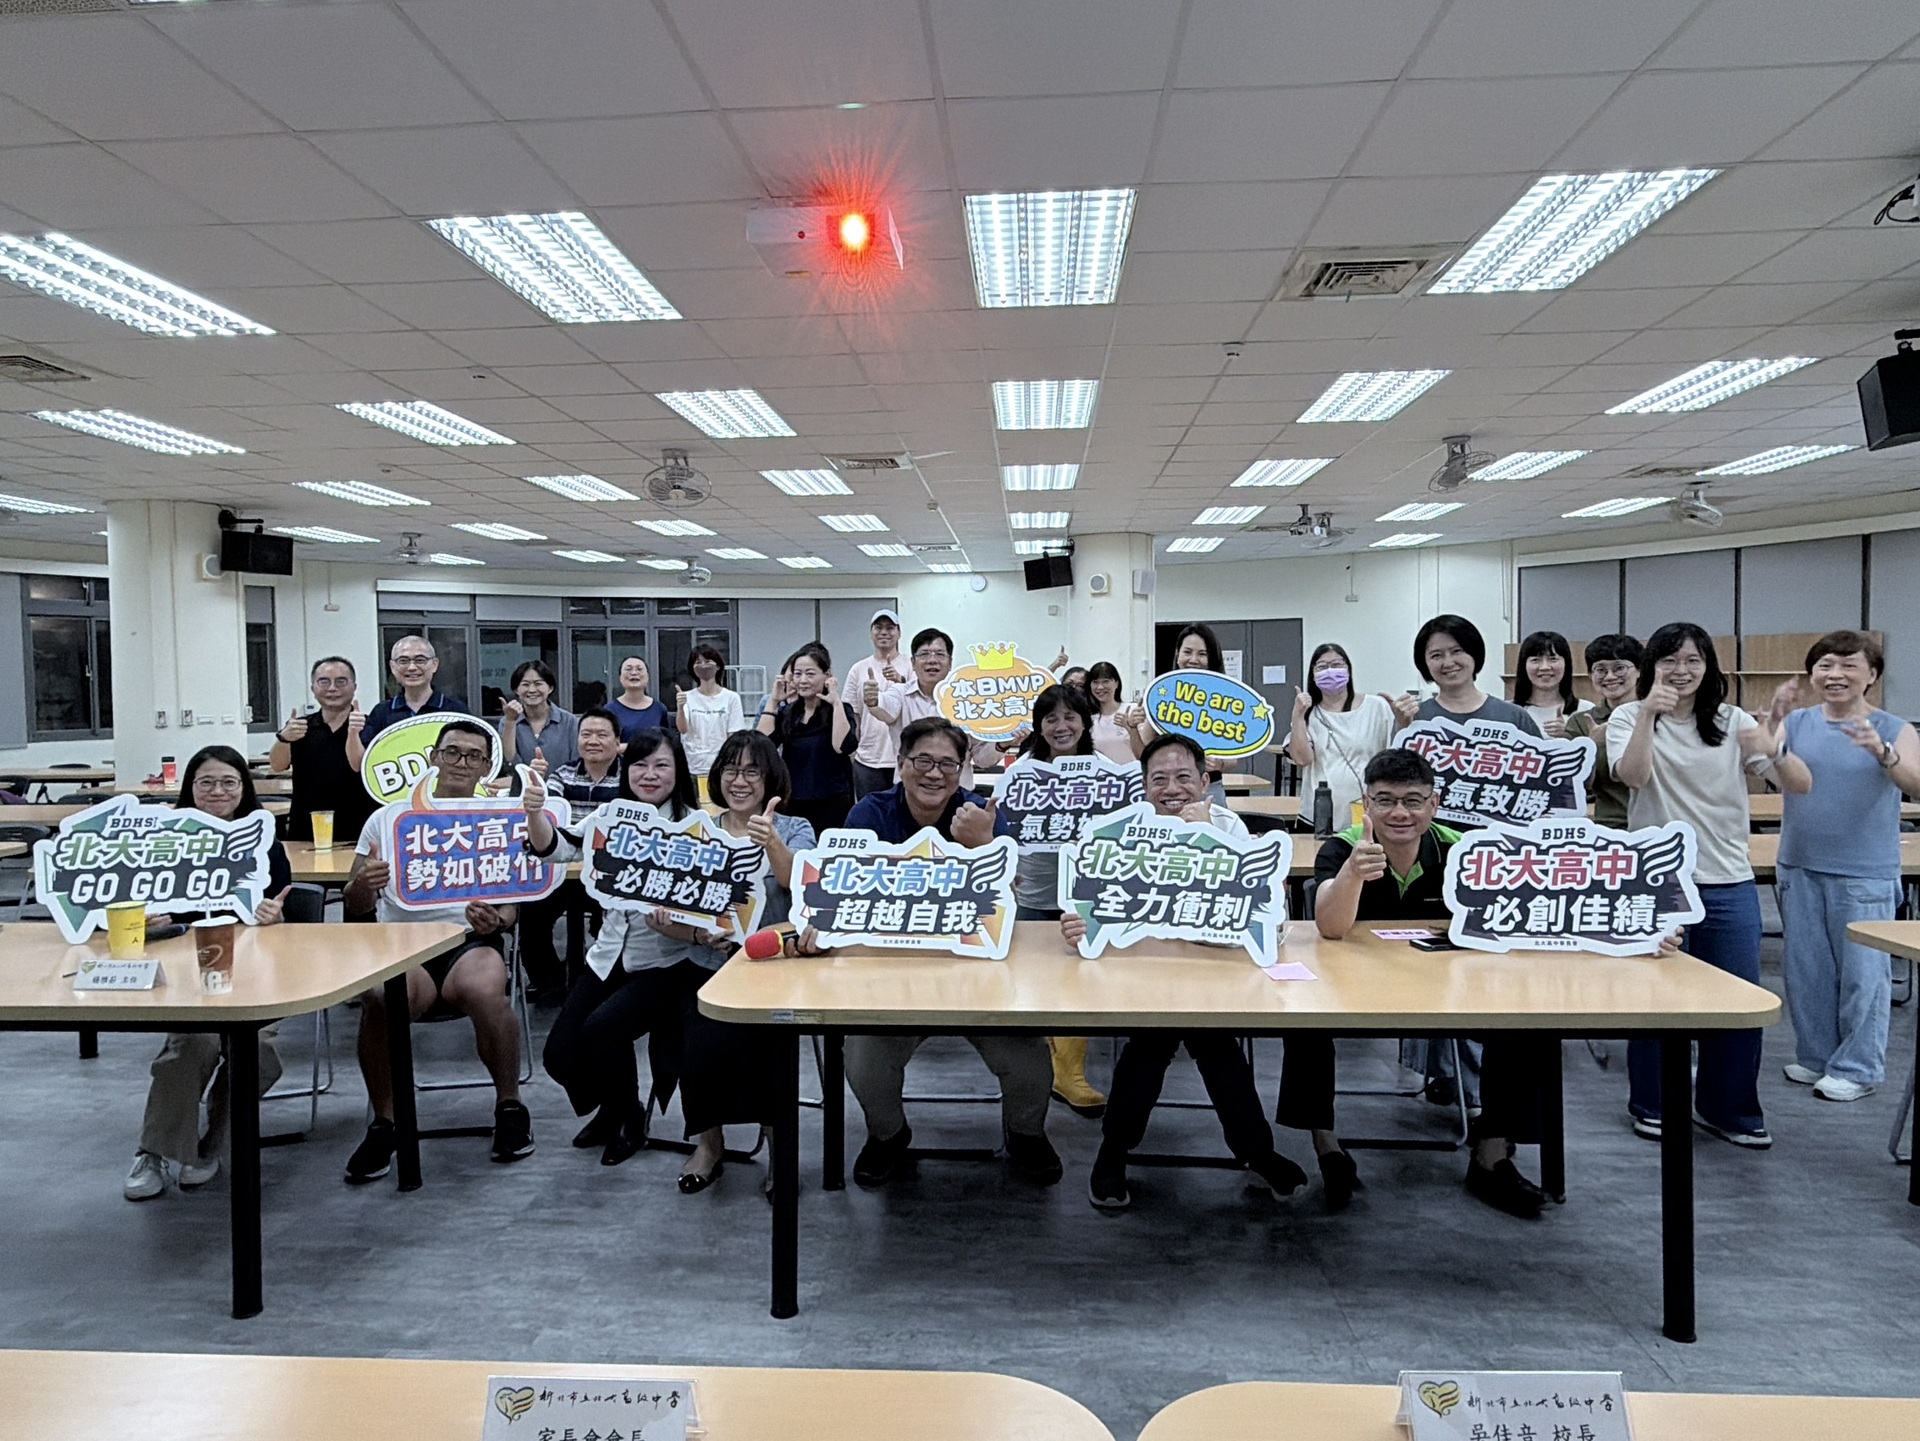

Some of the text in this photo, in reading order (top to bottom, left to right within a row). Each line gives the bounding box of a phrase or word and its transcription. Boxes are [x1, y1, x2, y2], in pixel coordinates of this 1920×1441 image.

[950, 674, 1045, 698] 本日MVP
[1174, 680, 1245, 715] We are
[1156, 700, 1246, 742] the best
[1472, 727, 1510, 739] BDHS
[372, 745, 435, 797] BD
[1060, 762, 1092, 772] BDHS
[1007, 777, 1125, 810] 北大高中
[110, 817, 154, 829] BDHS
[616, 808, 650, 822] BDHS
[57, 830, 223, 869] 北大高中
[607, 823, 729, 875] 北大高中
[827, 837, 868, 849] BDHS
[1126, 826, 1168, 841] BDHS
[1541, 827, 1586, 841] BDHS
[406, 851, 543, 892] 勢如破竹
[821, 857, 968, 896] 北大高中
[1079, 841, 1238, 888] 北大高中
[1461, 846, 1637, 890] 北大高中
[71, 868, 231, 904] GO GO GO
[614, 863, 732, 912] 必勝必勝
[831, 899, 978, 933] 超越自我
[1093, 883, 1252, 930] 全力衝刺
[1482, 894, 1657, 934] 必創佳績
